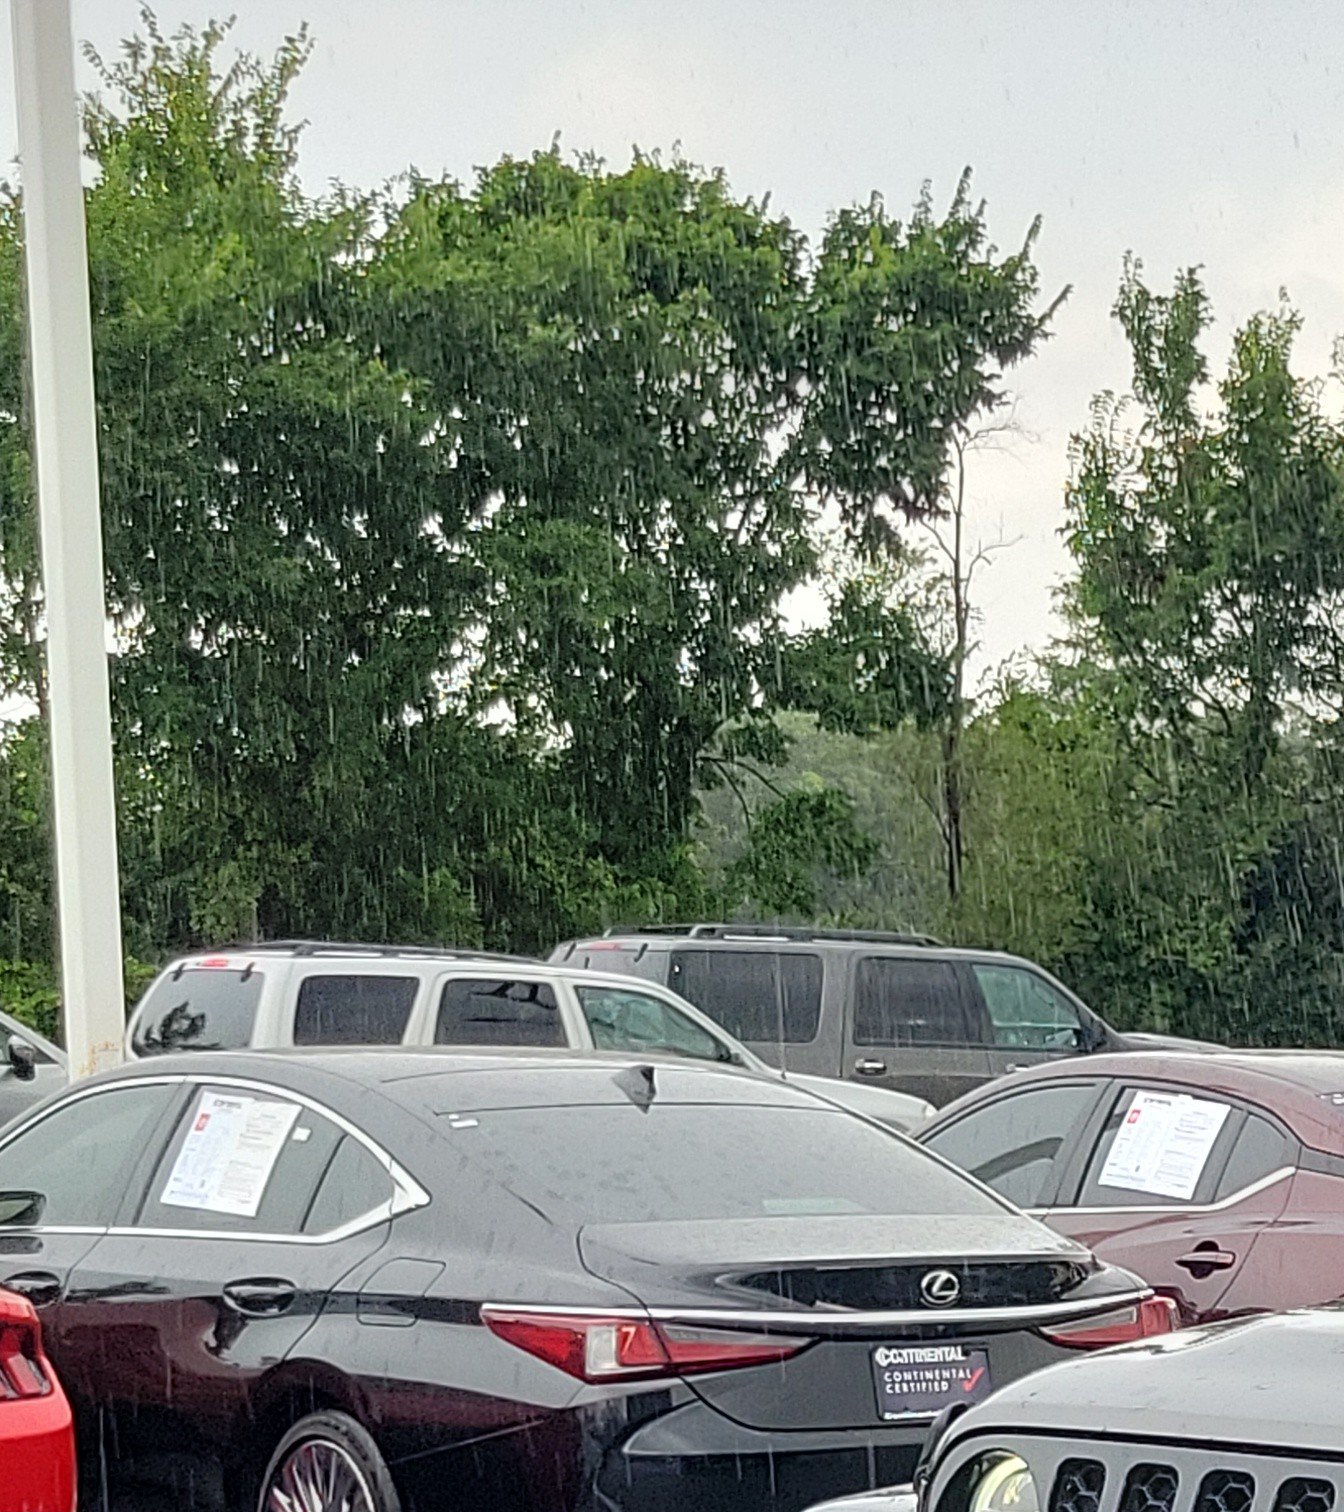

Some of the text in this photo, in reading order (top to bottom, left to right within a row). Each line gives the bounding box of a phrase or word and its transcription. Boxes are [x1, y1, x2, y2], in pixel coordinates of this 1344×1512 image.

[875, 1346, 967, 1367] CONTINENTAL
[884, 1368, 972, 1382] CONTINENTAL
[885, 1381, 949, 1394] CERTIFIED
